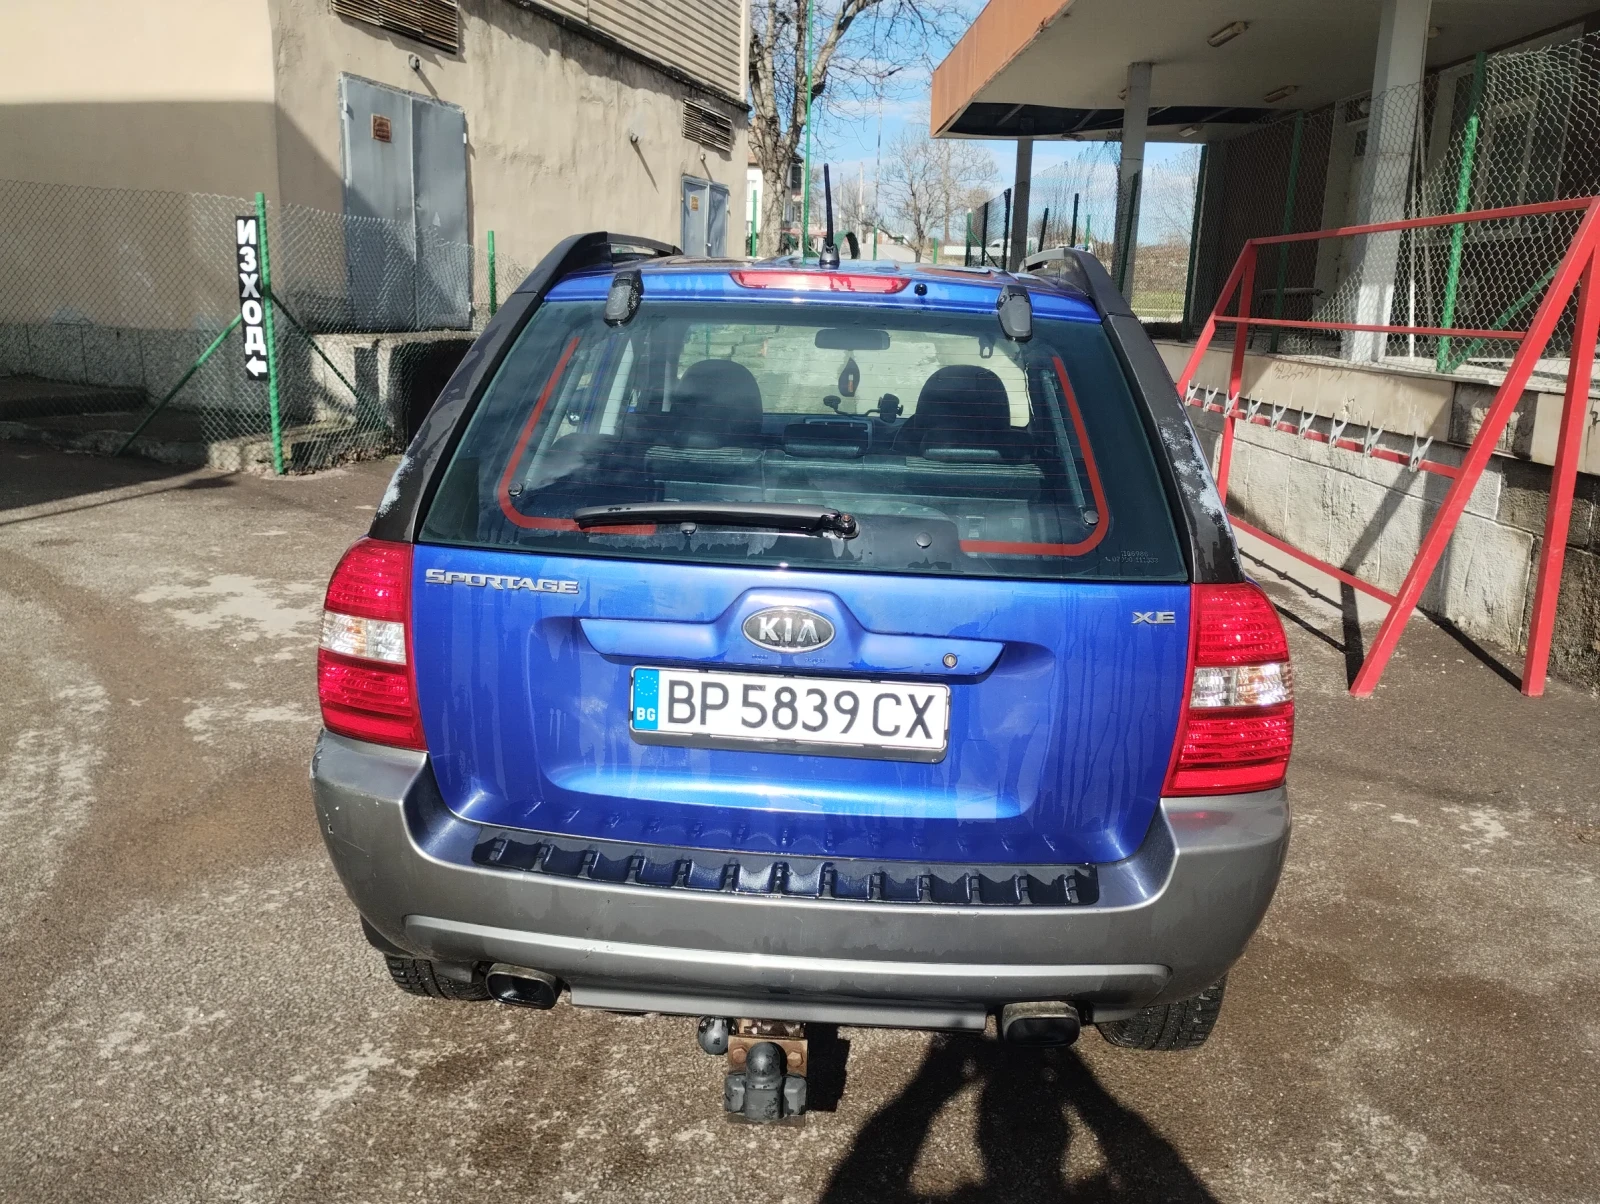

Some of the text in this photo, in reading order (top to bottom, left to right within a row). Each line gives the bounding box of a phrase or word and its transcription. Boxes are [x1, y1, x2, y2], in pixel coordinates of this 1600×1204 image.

[236, 219, 267, 356] ИЗХОД
[425, 568, 580, 594] SPORTAGE
[758, 616, 820, 643] KIA
[1131, 611, 1176, 624] XE
[636, 707, 656, 721] BG
[741, 683, 860, 734] 5839
